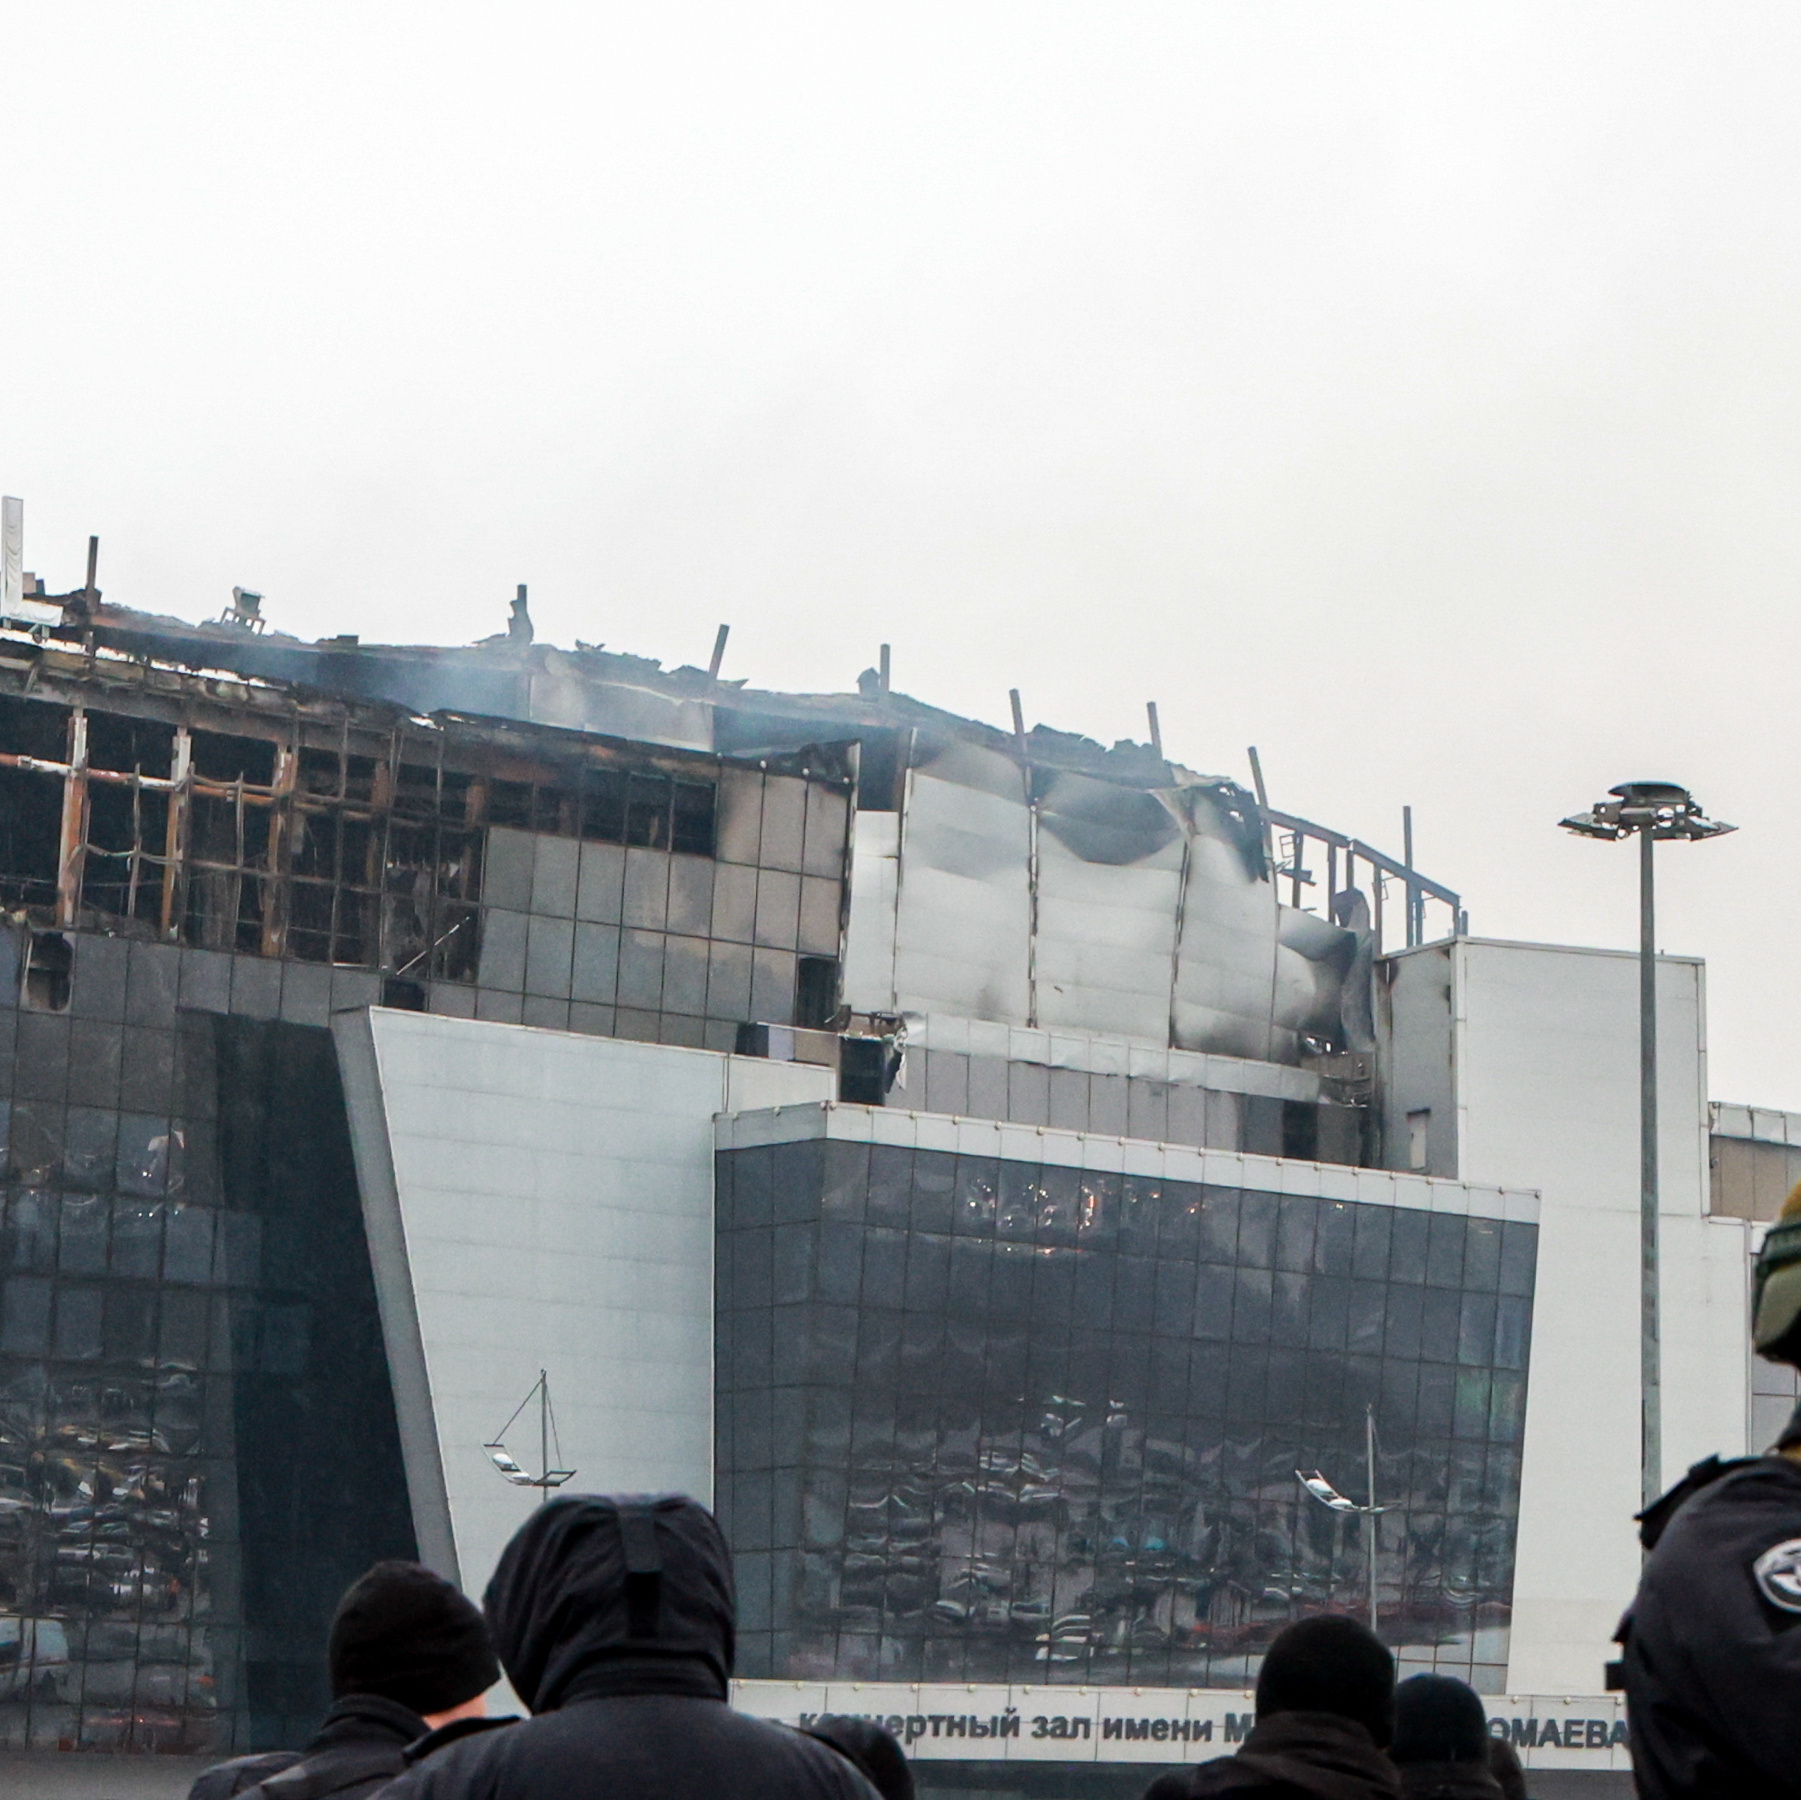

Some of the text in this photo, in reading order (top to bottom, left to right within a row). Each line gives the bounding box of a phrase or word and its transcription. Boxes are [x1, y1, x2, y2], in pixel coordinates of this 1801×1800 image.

[1031, 1714, 1091, 1740] зал
[1103, 1717, 1213, 1742] имени
[1486, 1716, 1629, 1749] ОМАЕВА
